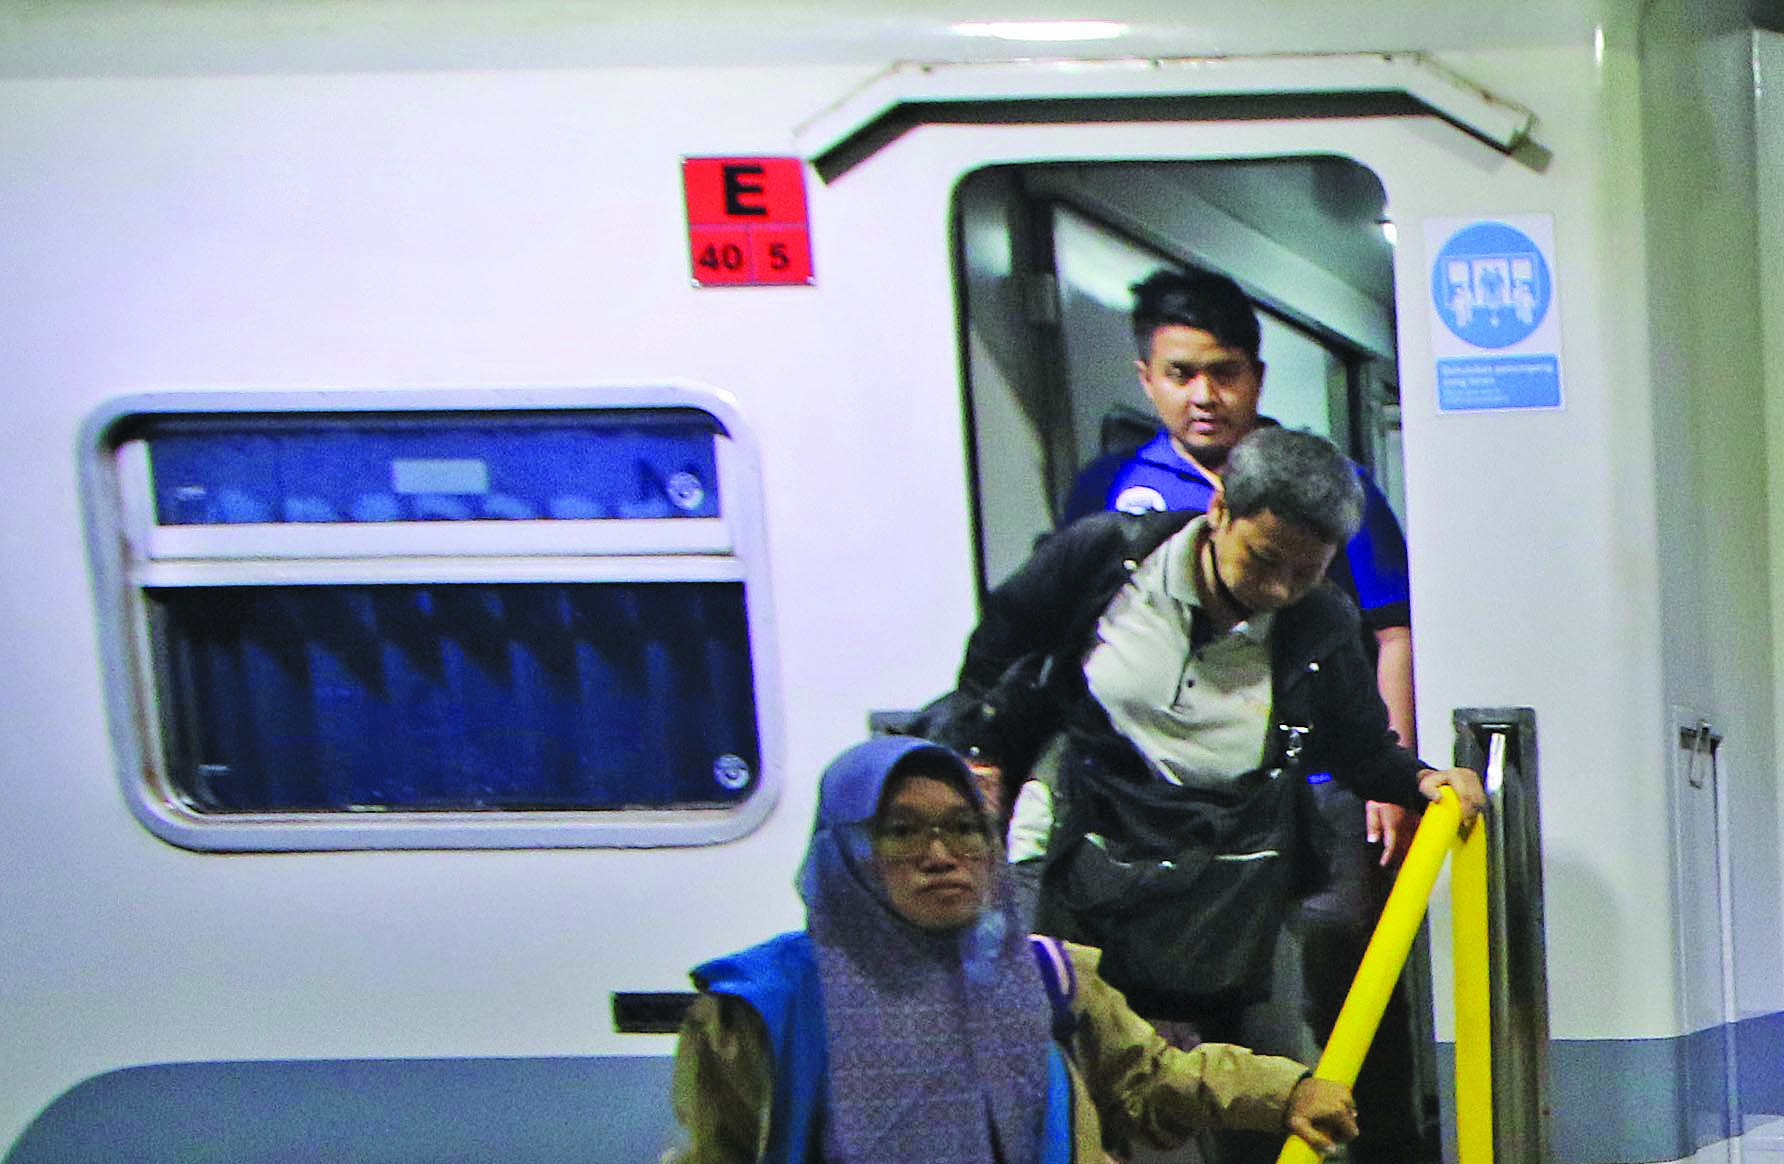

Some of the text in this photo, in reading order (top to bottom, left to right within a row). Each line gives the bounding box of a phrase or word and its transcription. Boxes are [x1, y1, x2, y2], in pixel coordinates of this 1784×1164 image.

[724, 165, 767, 215] E
[699, 243, 790, 270] 40 5
